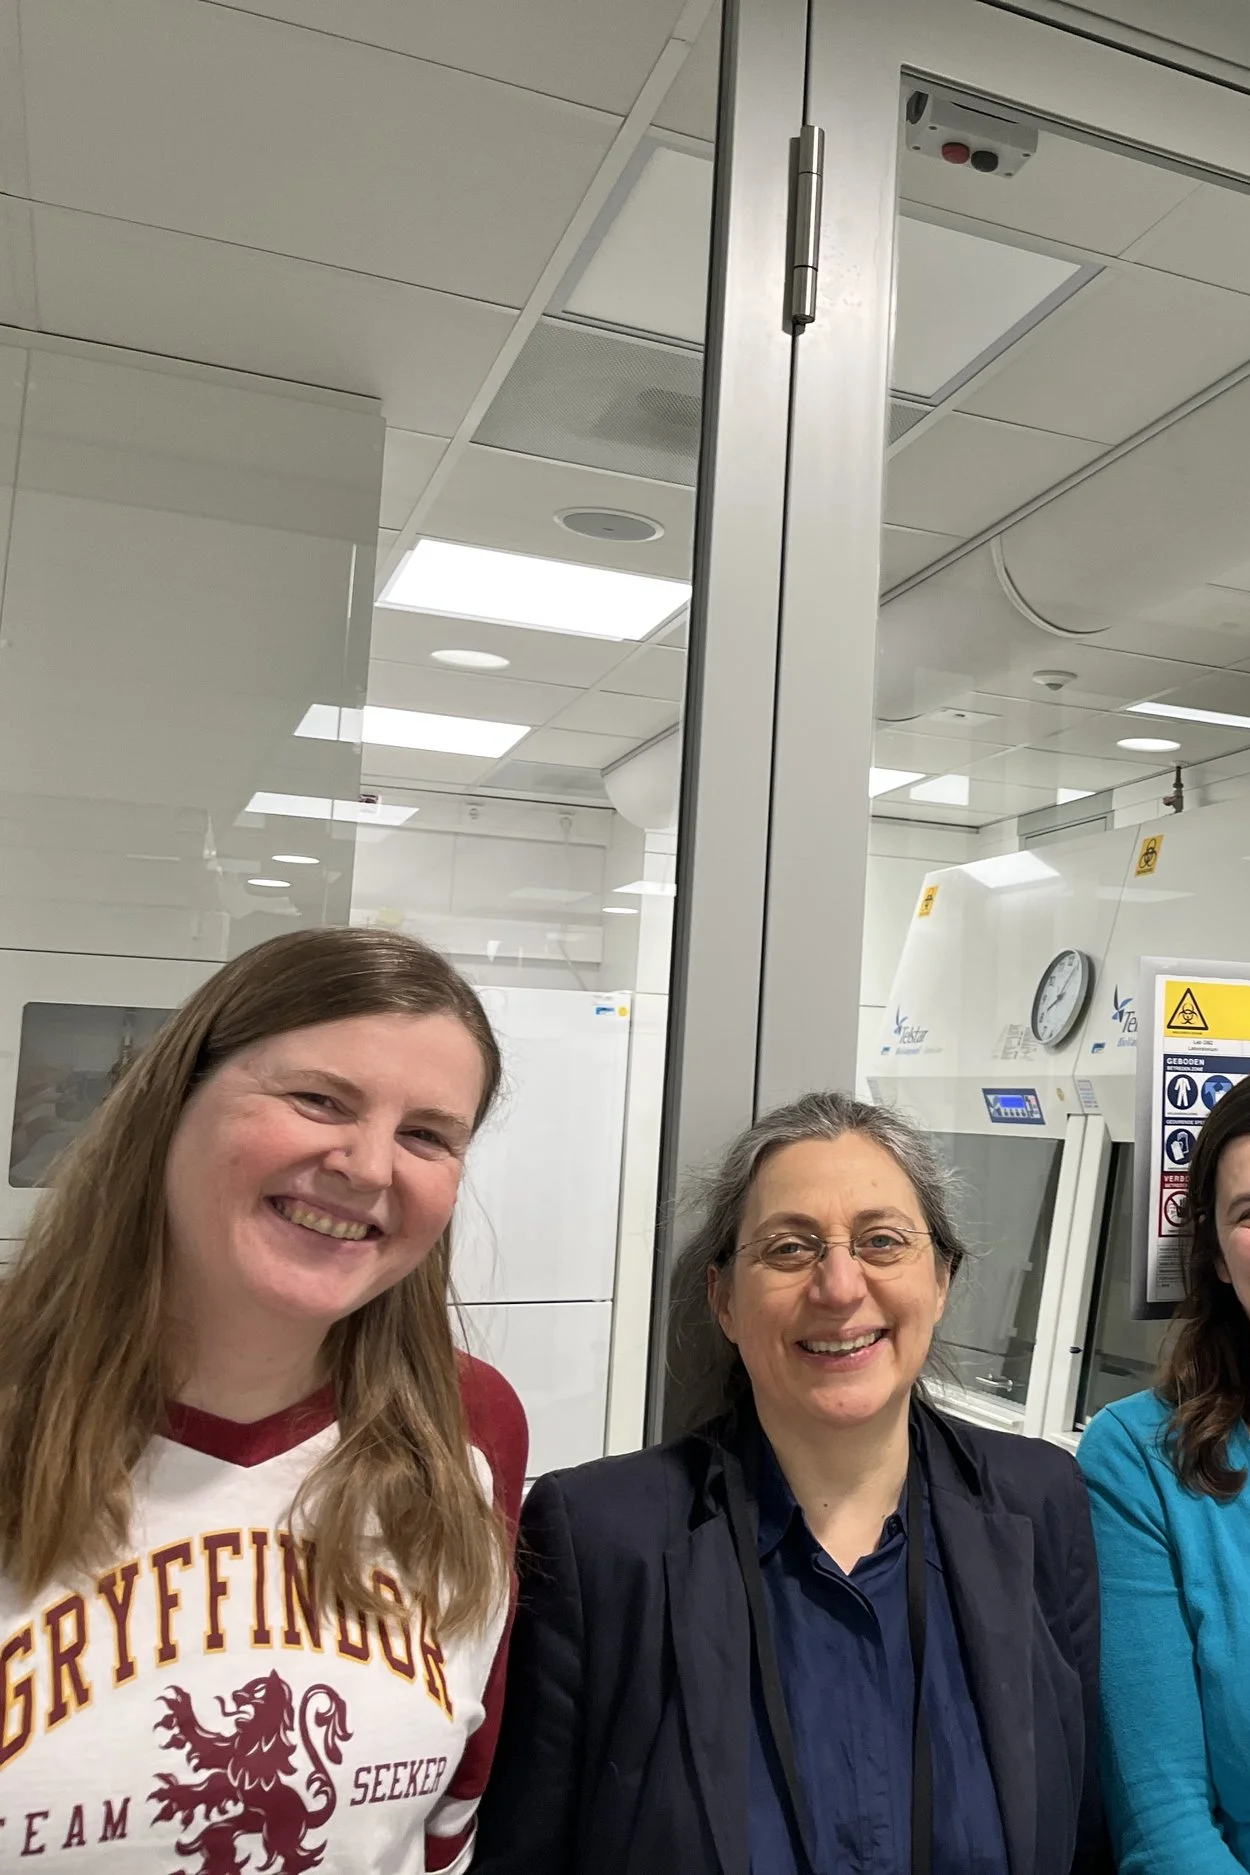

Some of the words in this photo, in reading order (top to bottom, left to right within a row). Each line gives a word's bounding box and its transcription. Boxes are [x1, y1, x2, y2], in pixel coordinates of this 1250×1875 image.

[1166, 1057, 1205, 1066] GEBODEN
[350, 1756, 447, 1807] SEEKER
[0, 1797, 131, 1857] EAM
